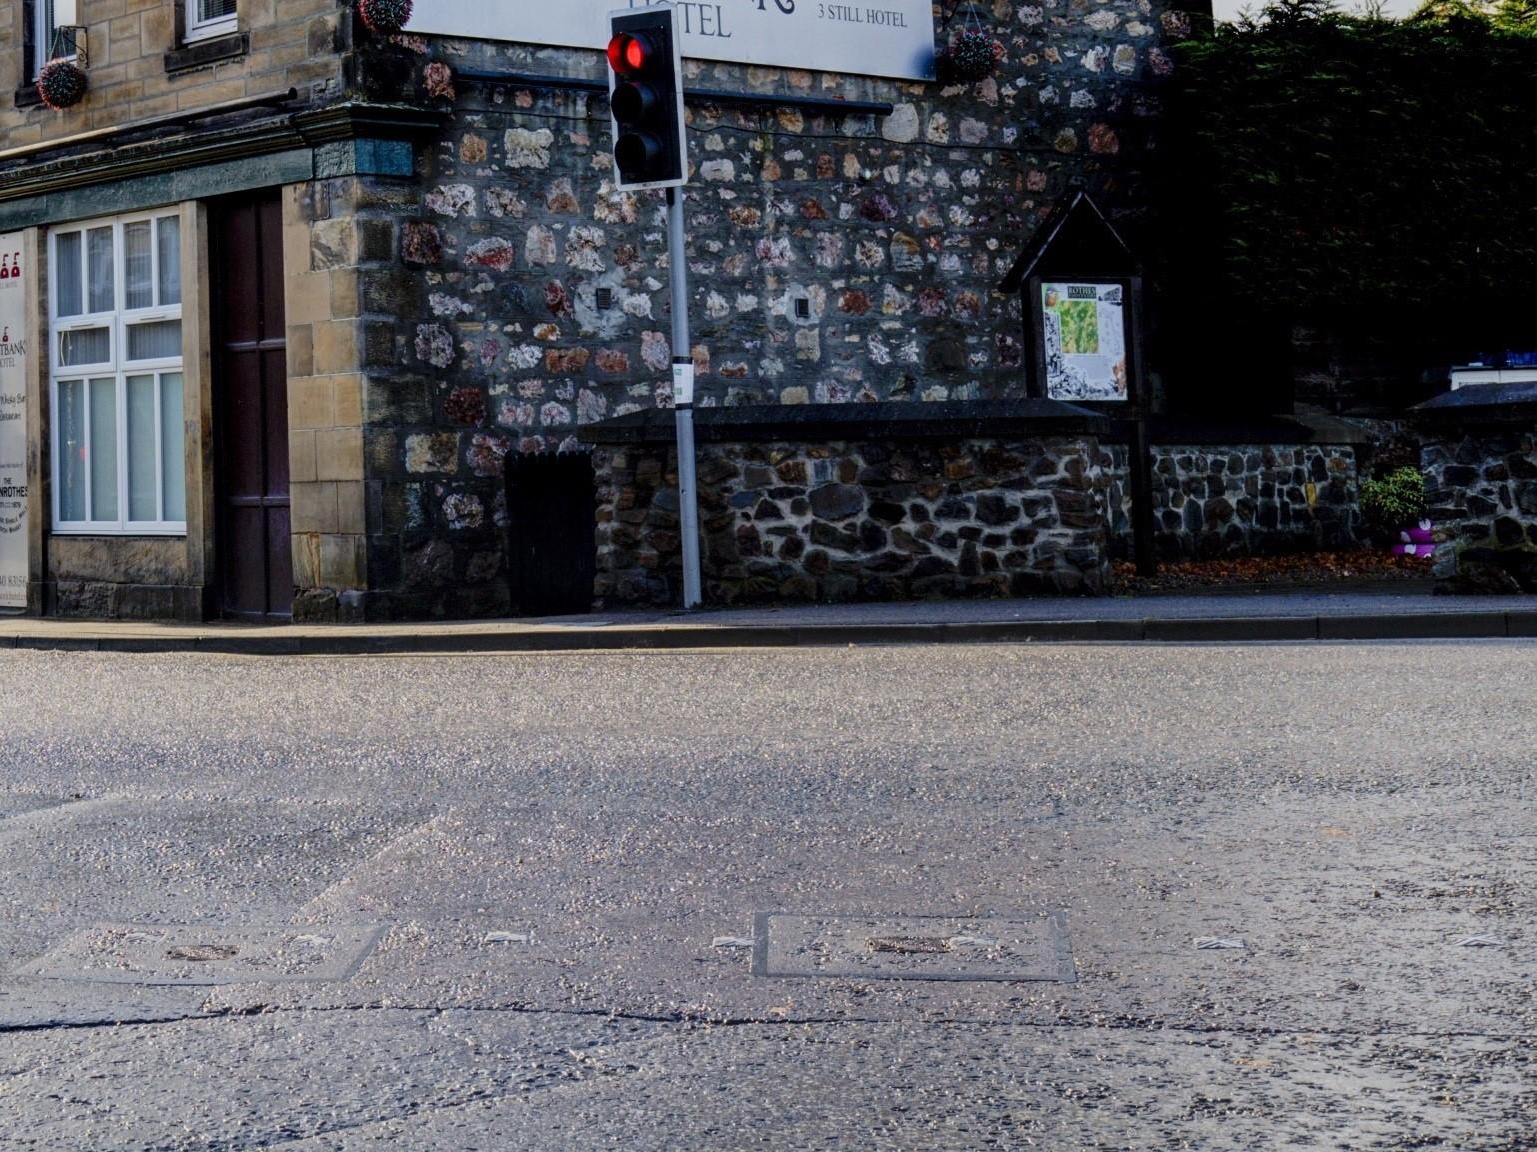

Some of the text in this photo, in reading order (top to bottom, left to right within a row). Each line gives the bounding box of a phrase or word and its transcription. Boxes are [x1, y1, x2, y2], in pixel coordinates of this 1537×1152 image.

[818, 3, 908, 27] 3 STILL HOTEL
[3, 477, 13, 485] THE
